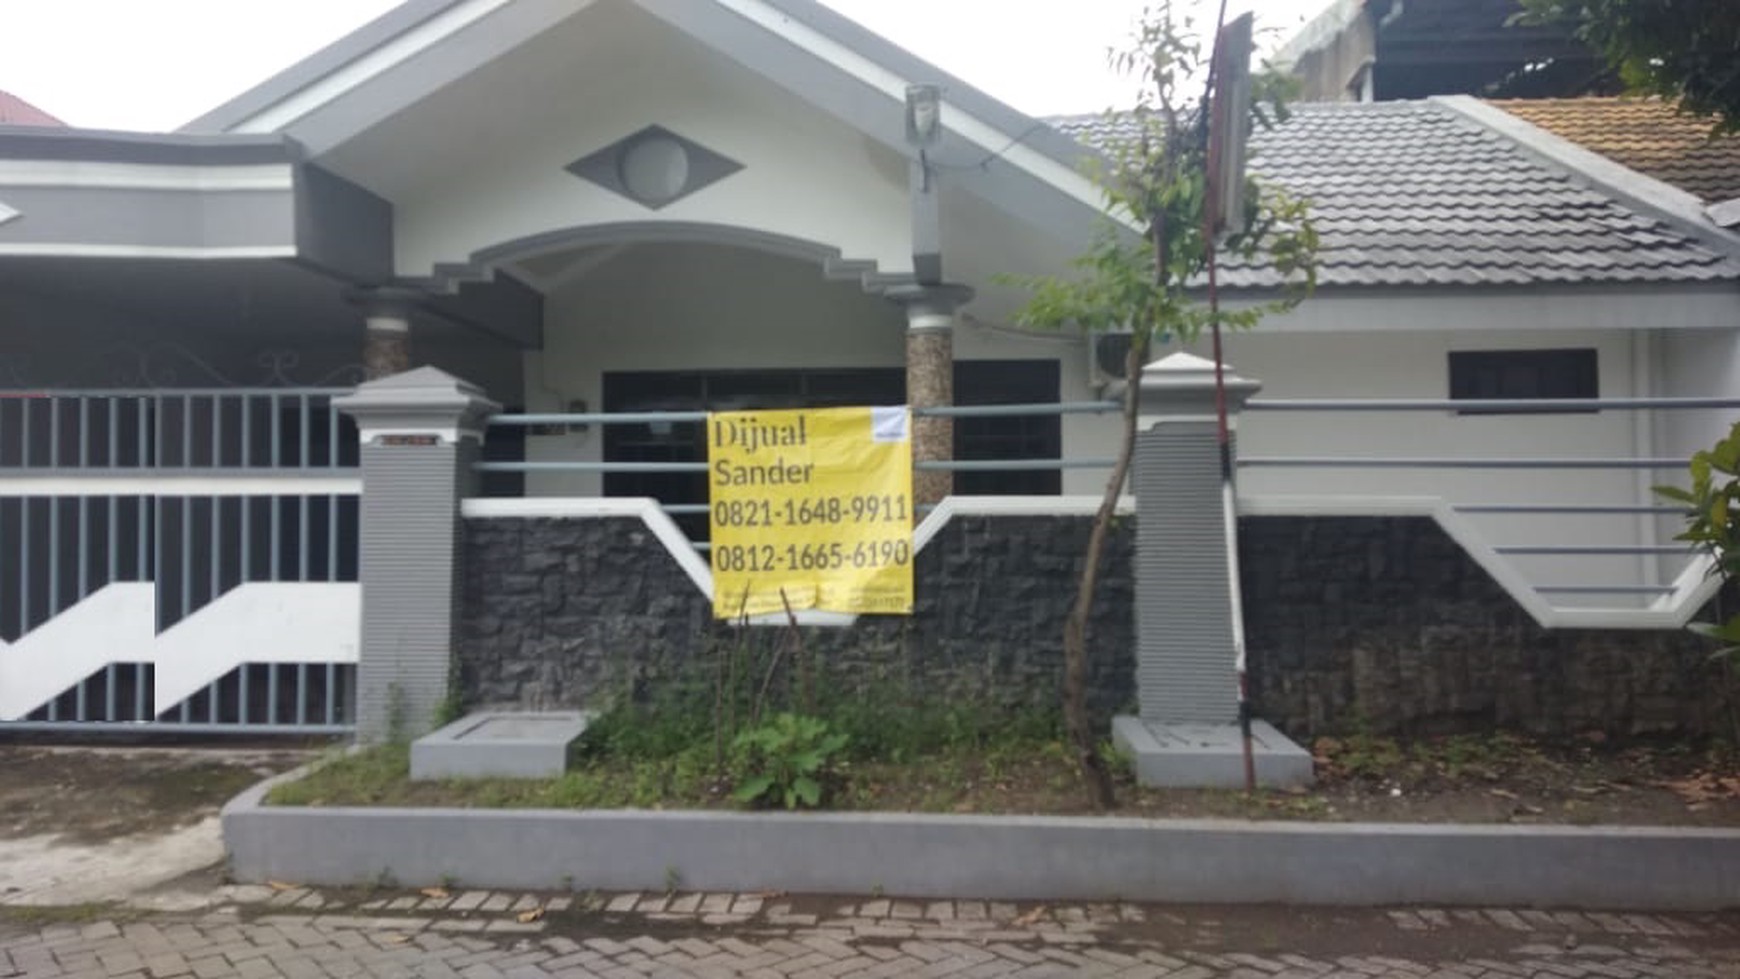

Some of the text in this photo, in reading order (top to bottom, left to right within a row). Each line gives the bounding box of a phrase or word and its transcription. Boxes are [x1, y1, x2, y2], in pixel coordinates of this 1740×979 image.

[714, 416, 806, 454] Dijual
[714, 457, 814, 486] Sander
[714, 495, 907, 527] 0821-1648-9911
[717, 539, 909, 572] 0812-1665-6190
